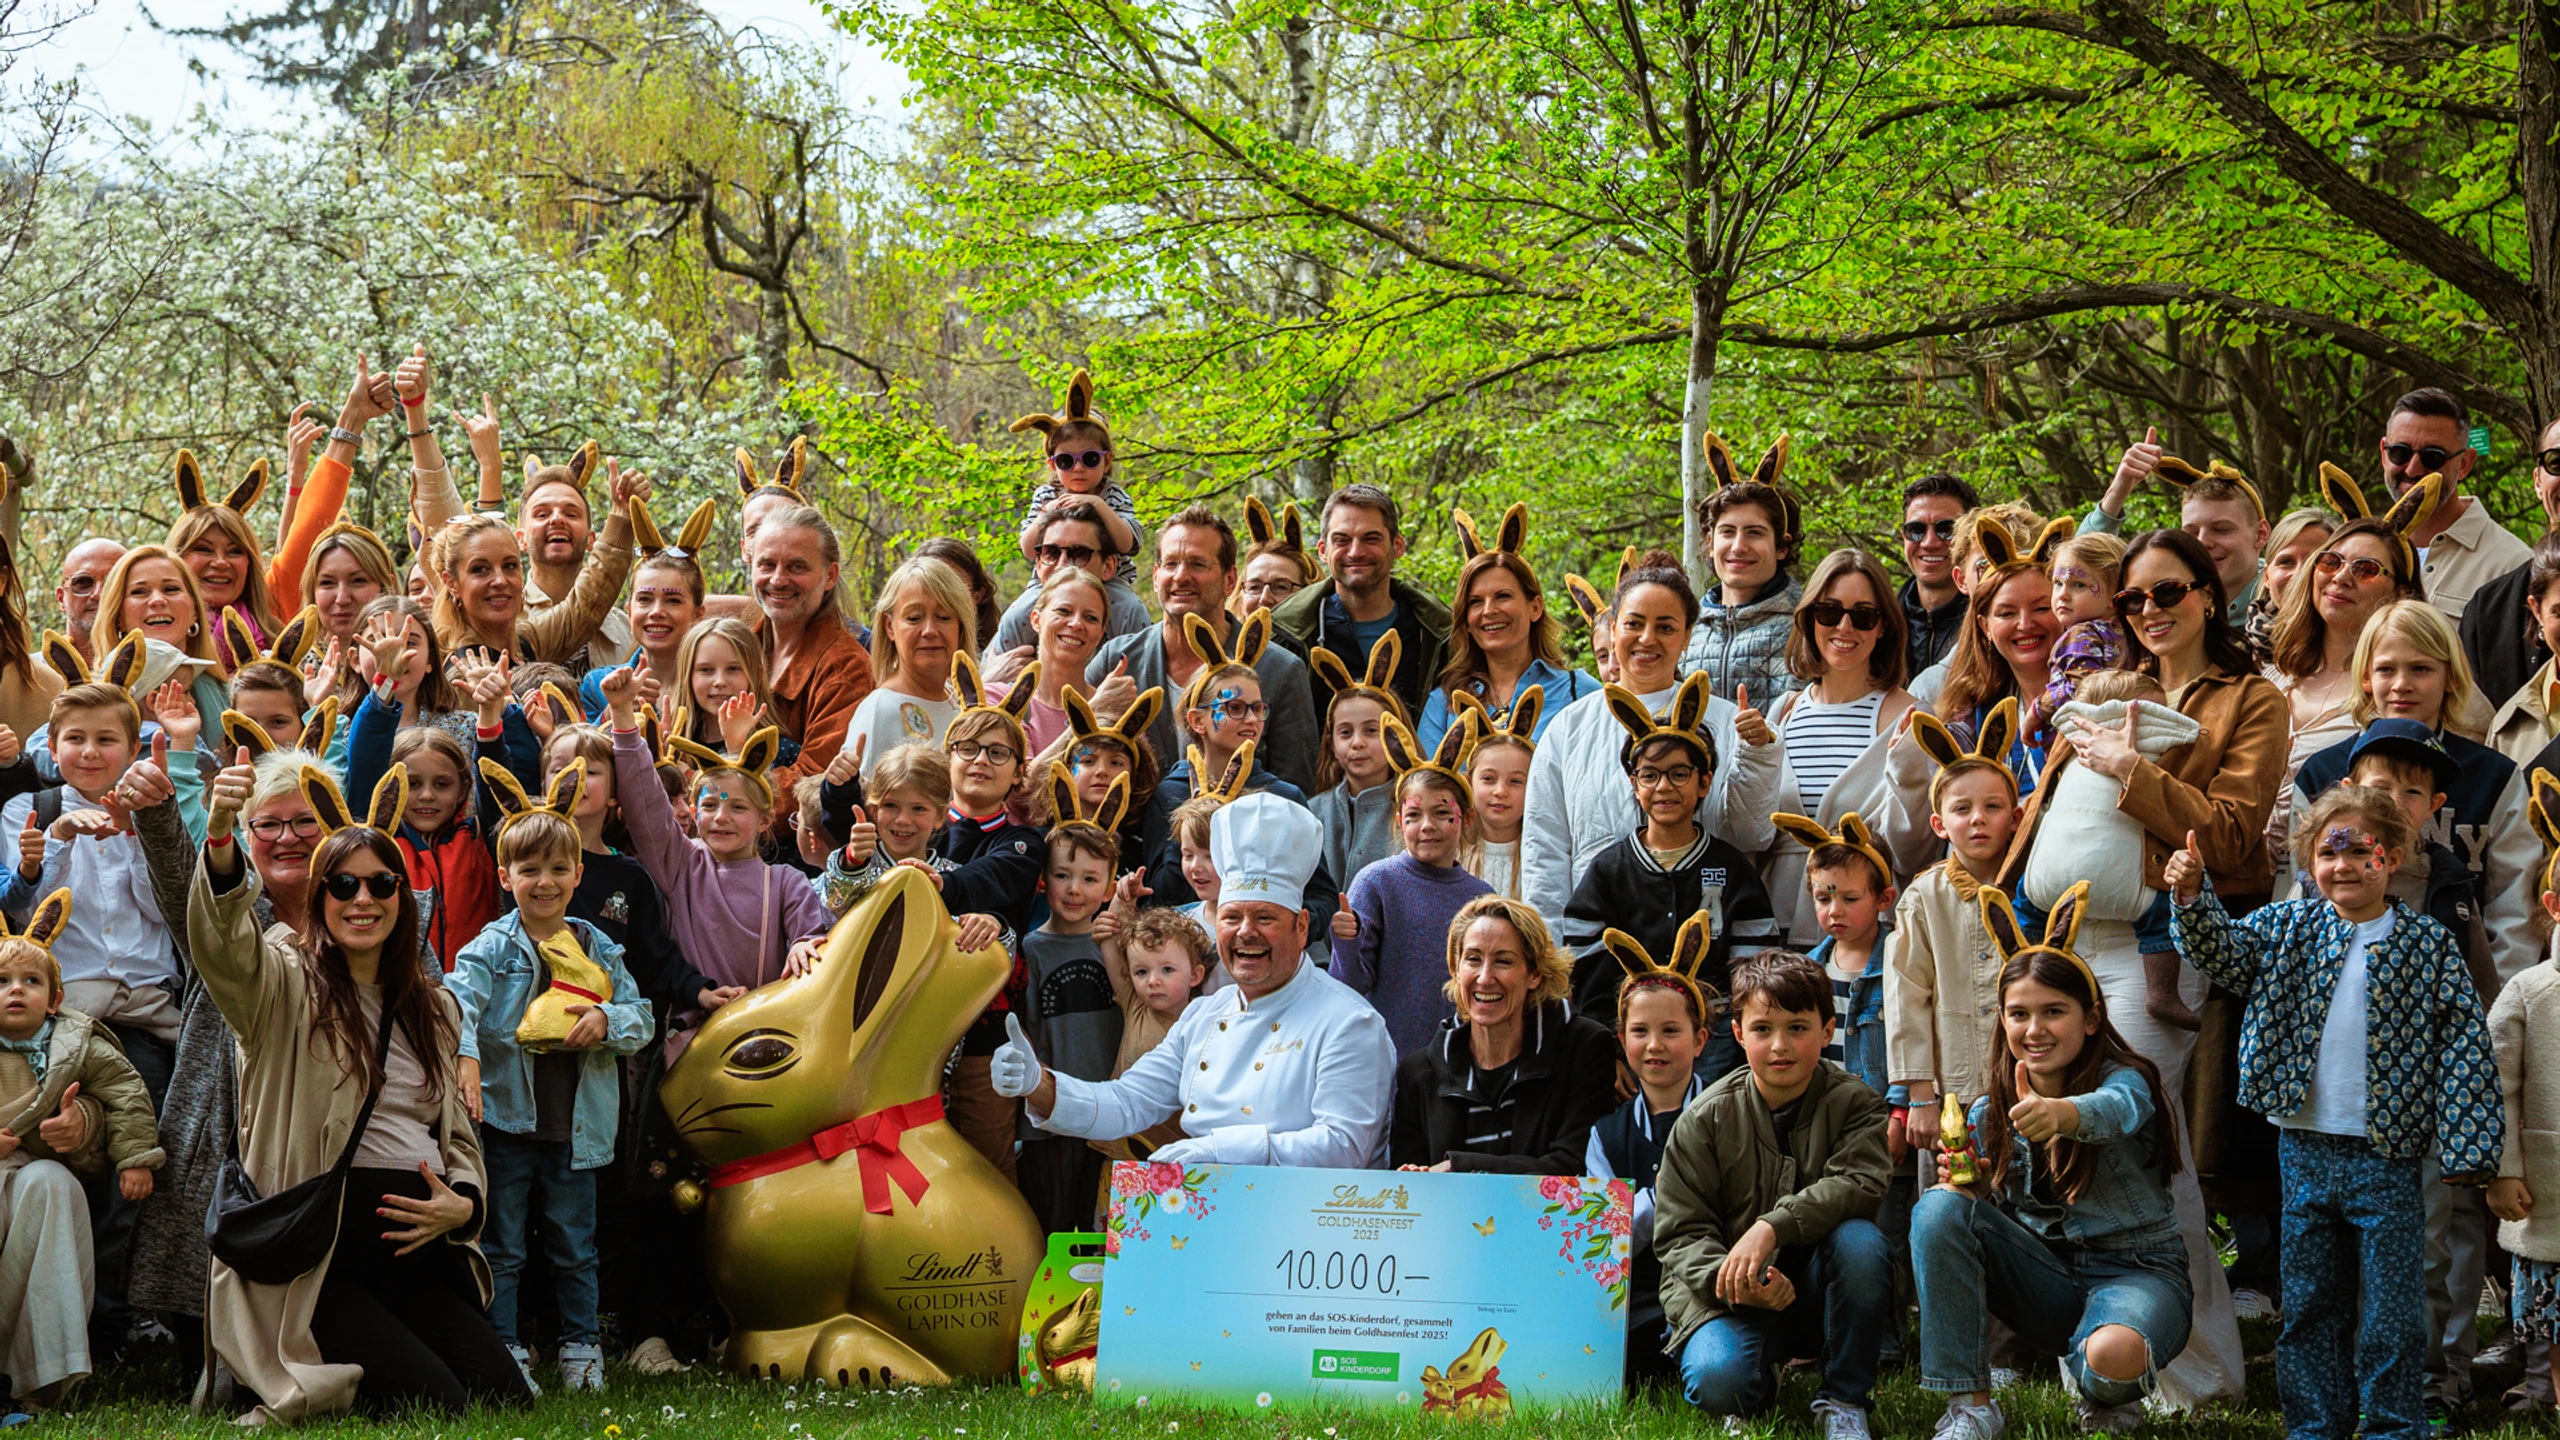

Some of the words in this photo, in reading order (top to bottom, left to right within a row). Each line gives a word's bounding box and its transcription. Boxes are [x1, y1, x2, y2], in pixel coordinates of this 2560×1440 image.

[2421, 807, 2489, 871] NY
[1042, 982, 1052, 1015] ENJOY
[1052, 965, 1077, 980] TODAY
[1082, 963, 1099, 974] AND
[1325, 1184, 1393, 1208] Lindt
[1317, 1215, 1414, 1230] GOLDHASENFEST
[1353, 1229, 1379, 1240] 2025
[898, 1251, 983, 1282] Lindt
[897, 1289, 1007, 1312] GOLDHASE
[908, 1313, 965, 1331] LAPIN
[971, 1310, 999, 1328] OR
[1265, 1310, 1293, 1322] gehen
[1309, 1312, 1324, 1321] das
[1327, 1312, 1400, 1326] SOS-Kinderdorf,
[1403, 1317, 1453, 1328] gesammelt
[1269, 1325, 1285, 1333] von
[1288, 1324, 1326, 1335] Familien
[1328, 1325, 1352, 1335] beim
[1354, 1327, 1419, 1339] Goldhasenfest
[1421, 1330, 1448, 1340] 2025!
[1340, 1356, 1357, 1365] SOS
[1340, 1365, 1392, 1375] KINDERDORF
